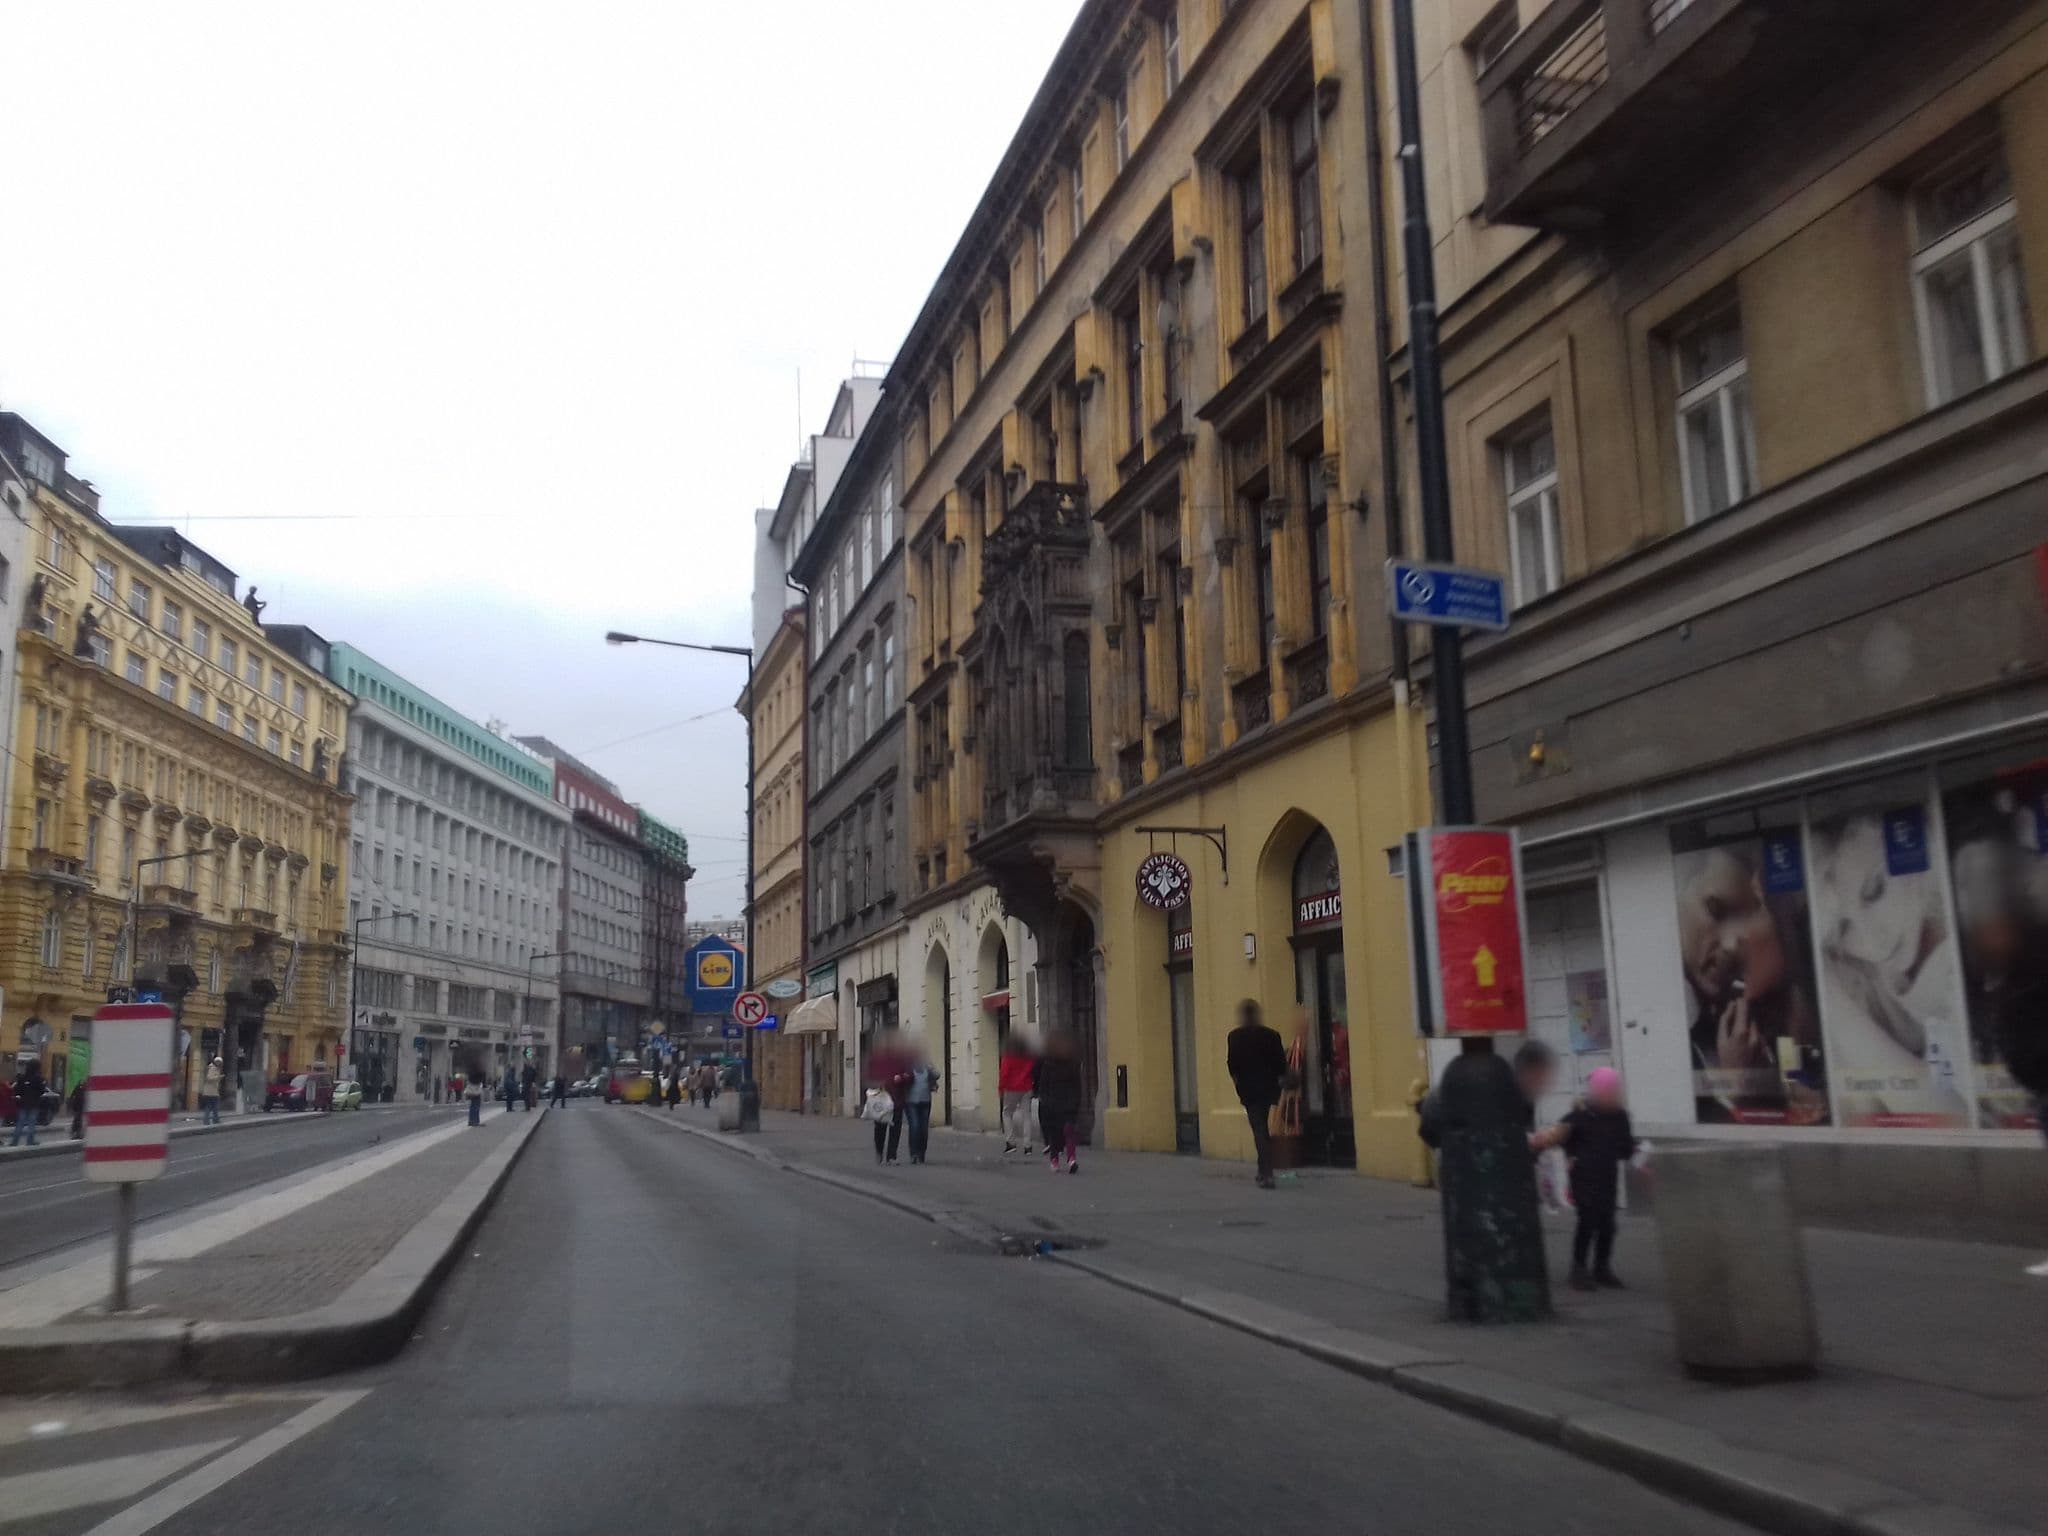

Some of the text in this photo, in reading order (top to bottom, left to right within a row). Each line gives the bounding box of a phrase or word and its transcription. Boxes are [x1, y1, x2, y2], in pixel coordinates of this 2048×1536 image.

[1141, 854, 1188, 879] AFFLICTION
[1142, 887, 1186, 908] LIVE FAST
